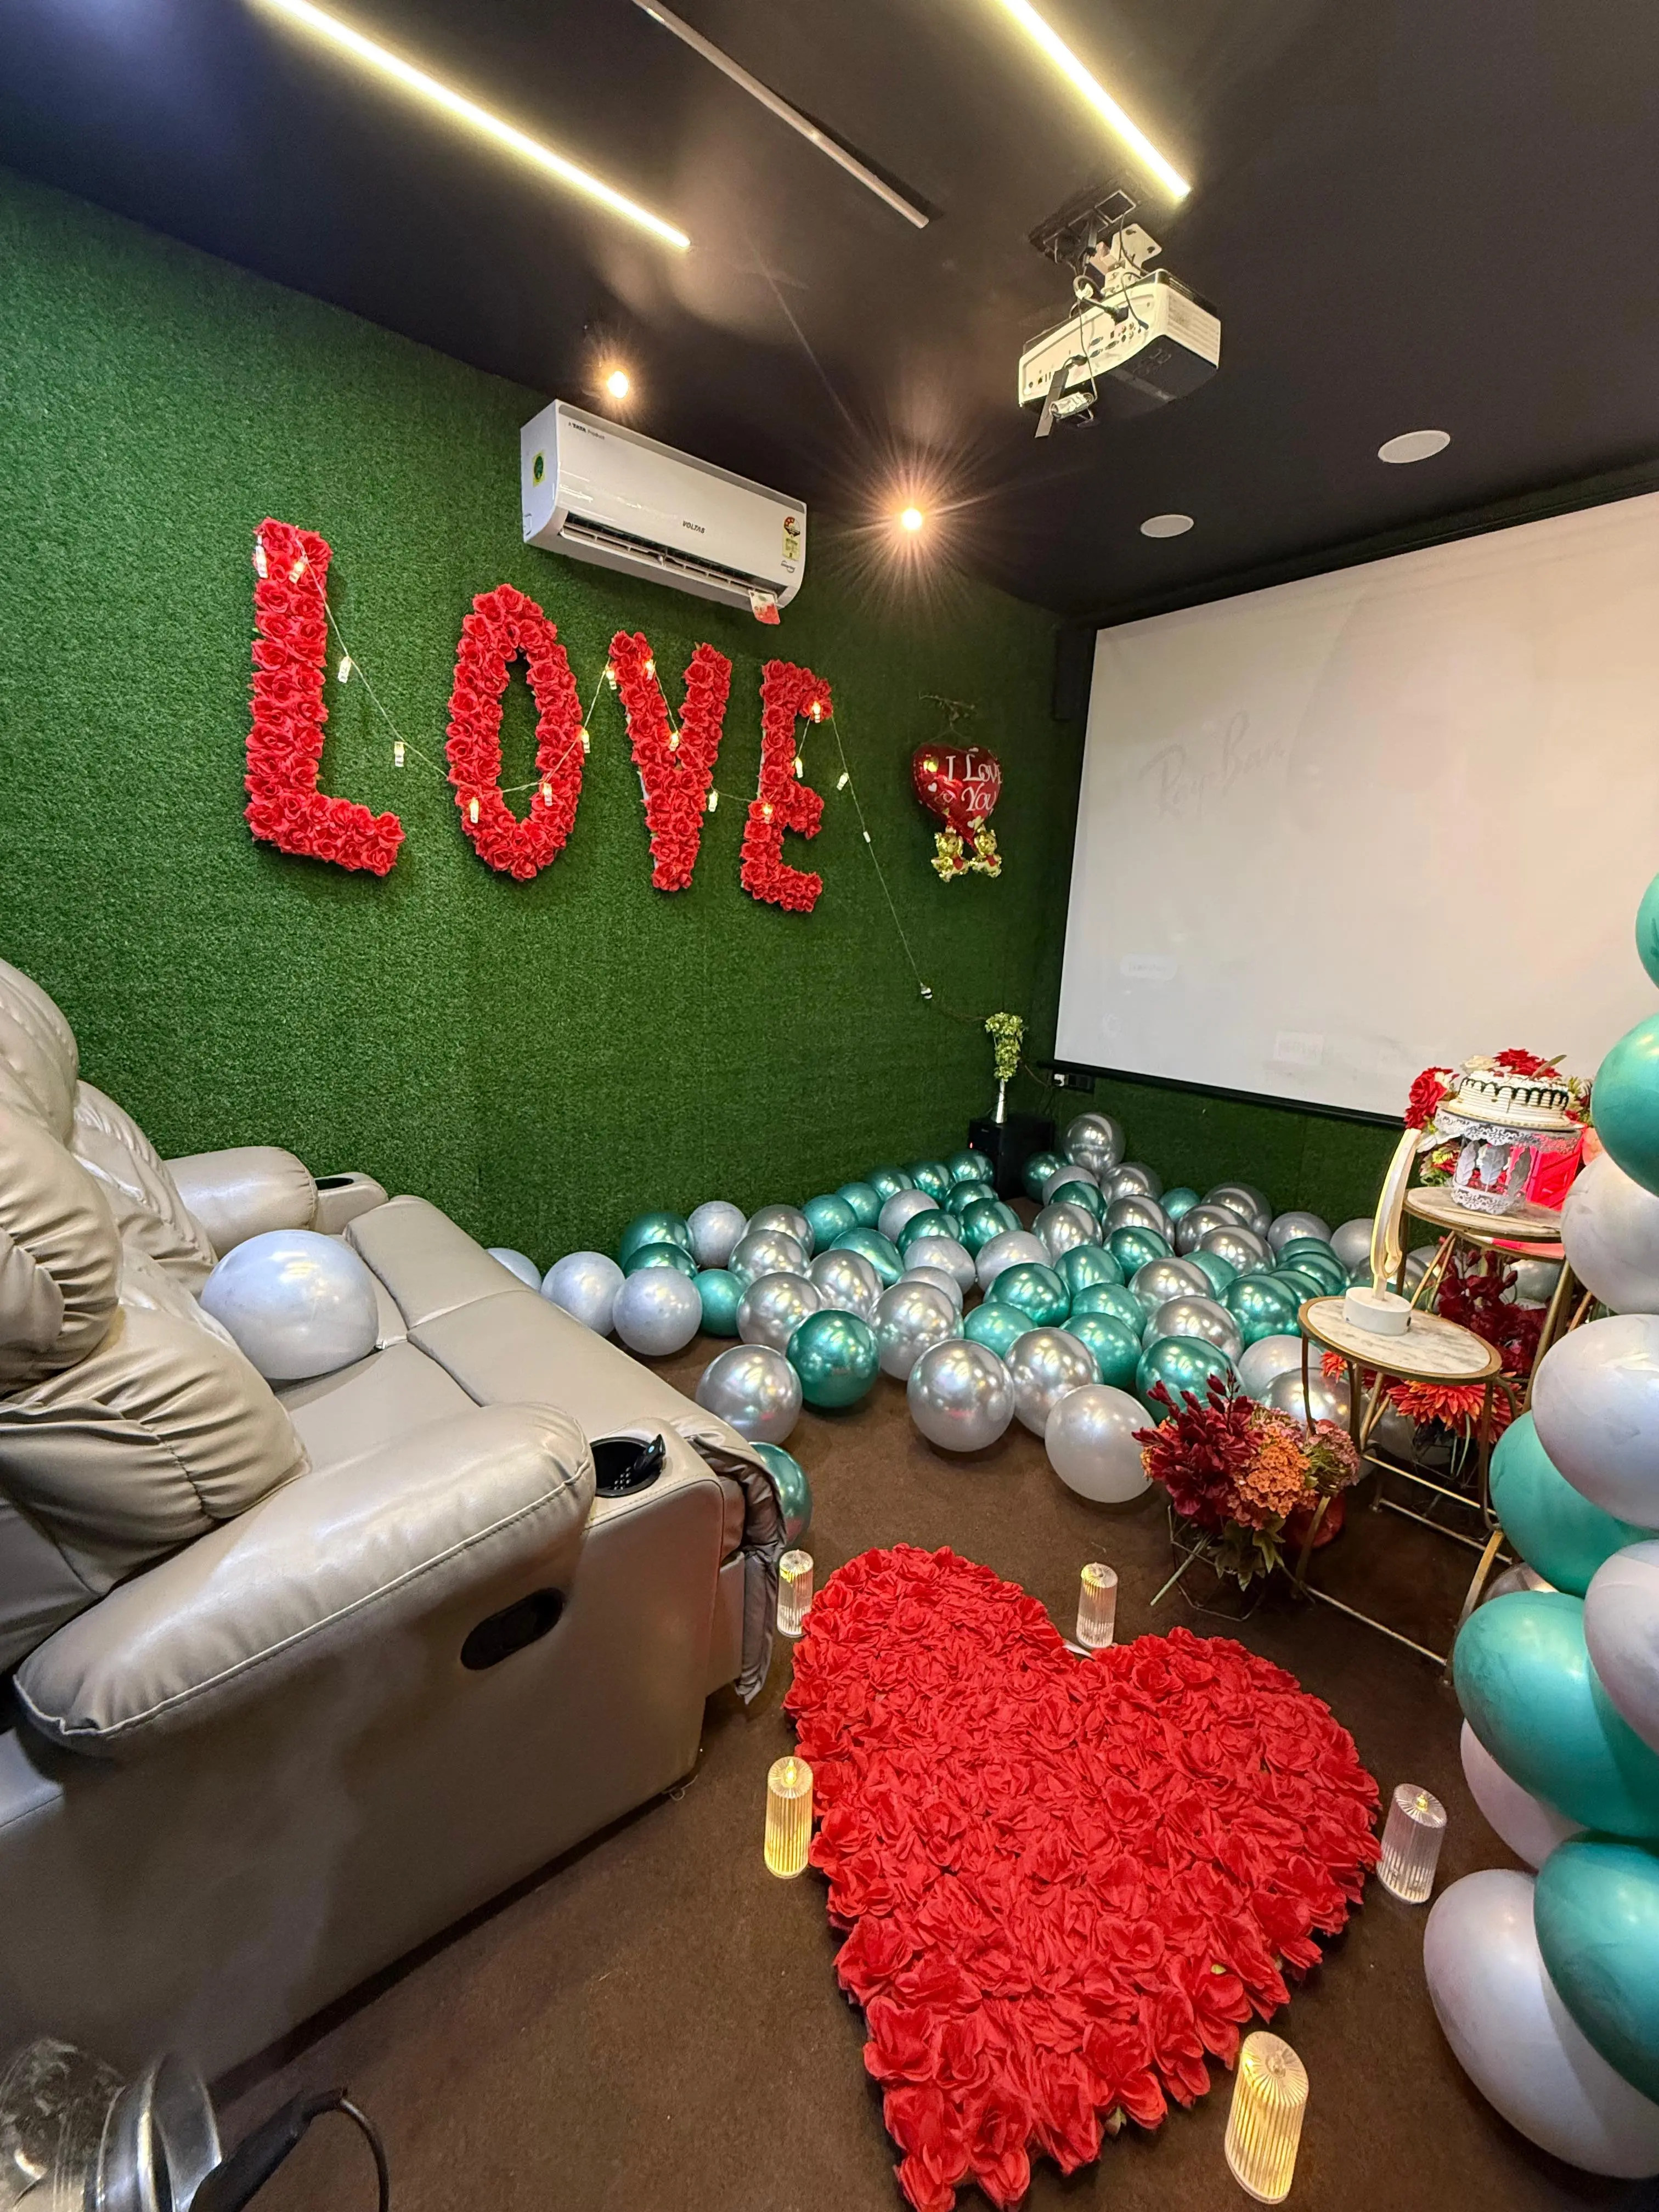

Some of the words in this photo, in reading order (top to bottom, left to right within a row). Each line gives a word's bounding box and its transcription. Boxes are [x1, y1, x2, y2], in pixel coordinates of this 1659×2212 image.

[682, 520, 706, 534] VOLTAS
[244, 517, 834, 912] LOVE
[945, 755, 956, 782] I
